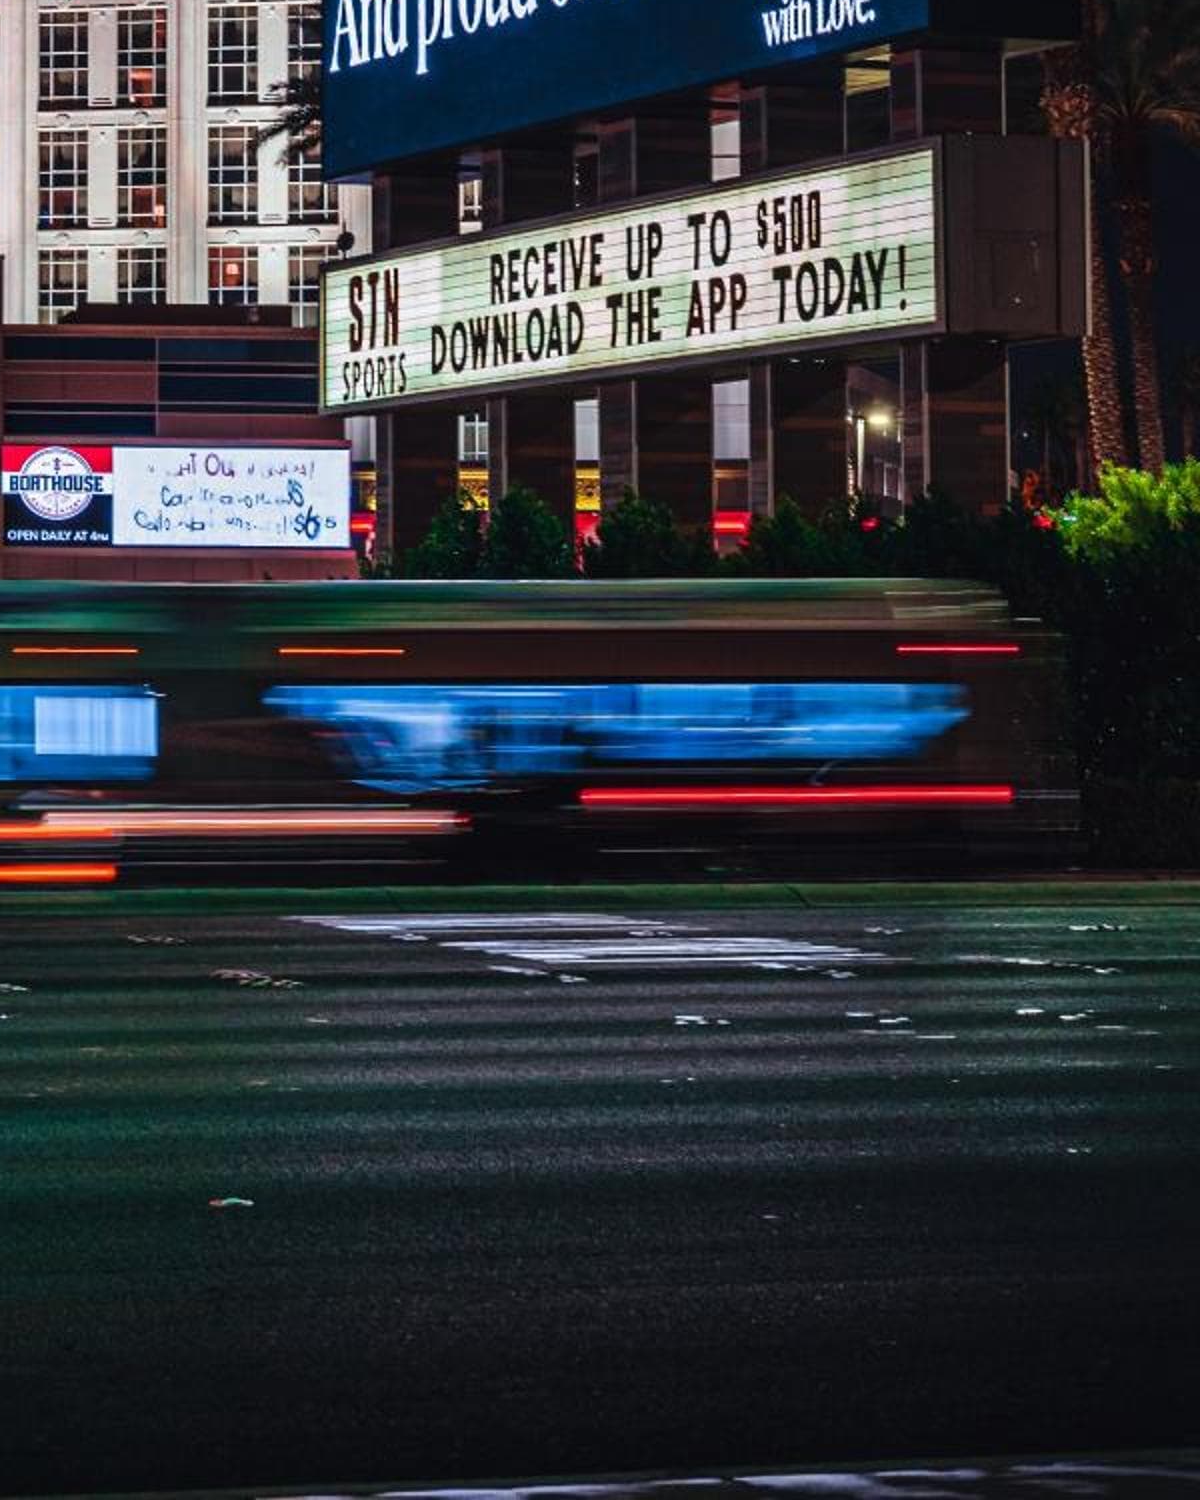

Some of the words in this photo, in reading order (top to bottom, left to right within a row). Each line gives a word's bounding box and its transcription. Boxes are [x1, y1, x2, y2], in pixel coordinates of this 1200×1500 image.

[490, 232, 604, 305] RECEIVE
[625, 222, 663, 280] UP
[687, 210, 732, 270] TO
[757, 190, 821, 255] $500
[350, 267, 399, 352] STN
[431, 301, 585, 375] DOWNLOAD
[606, 287, 661, 348] THE
[686, 272, 747, 337] APP
[772, 245, 906, 323] TODAY!
[343, 352, 407, 401] SPORTS
[9, 475, 104, 492] BOATHOUSE
[7, 529, 39, 541] OPEN
[41, 529, 72, 541] DAILY
[73, 530, 89, 541] AT
